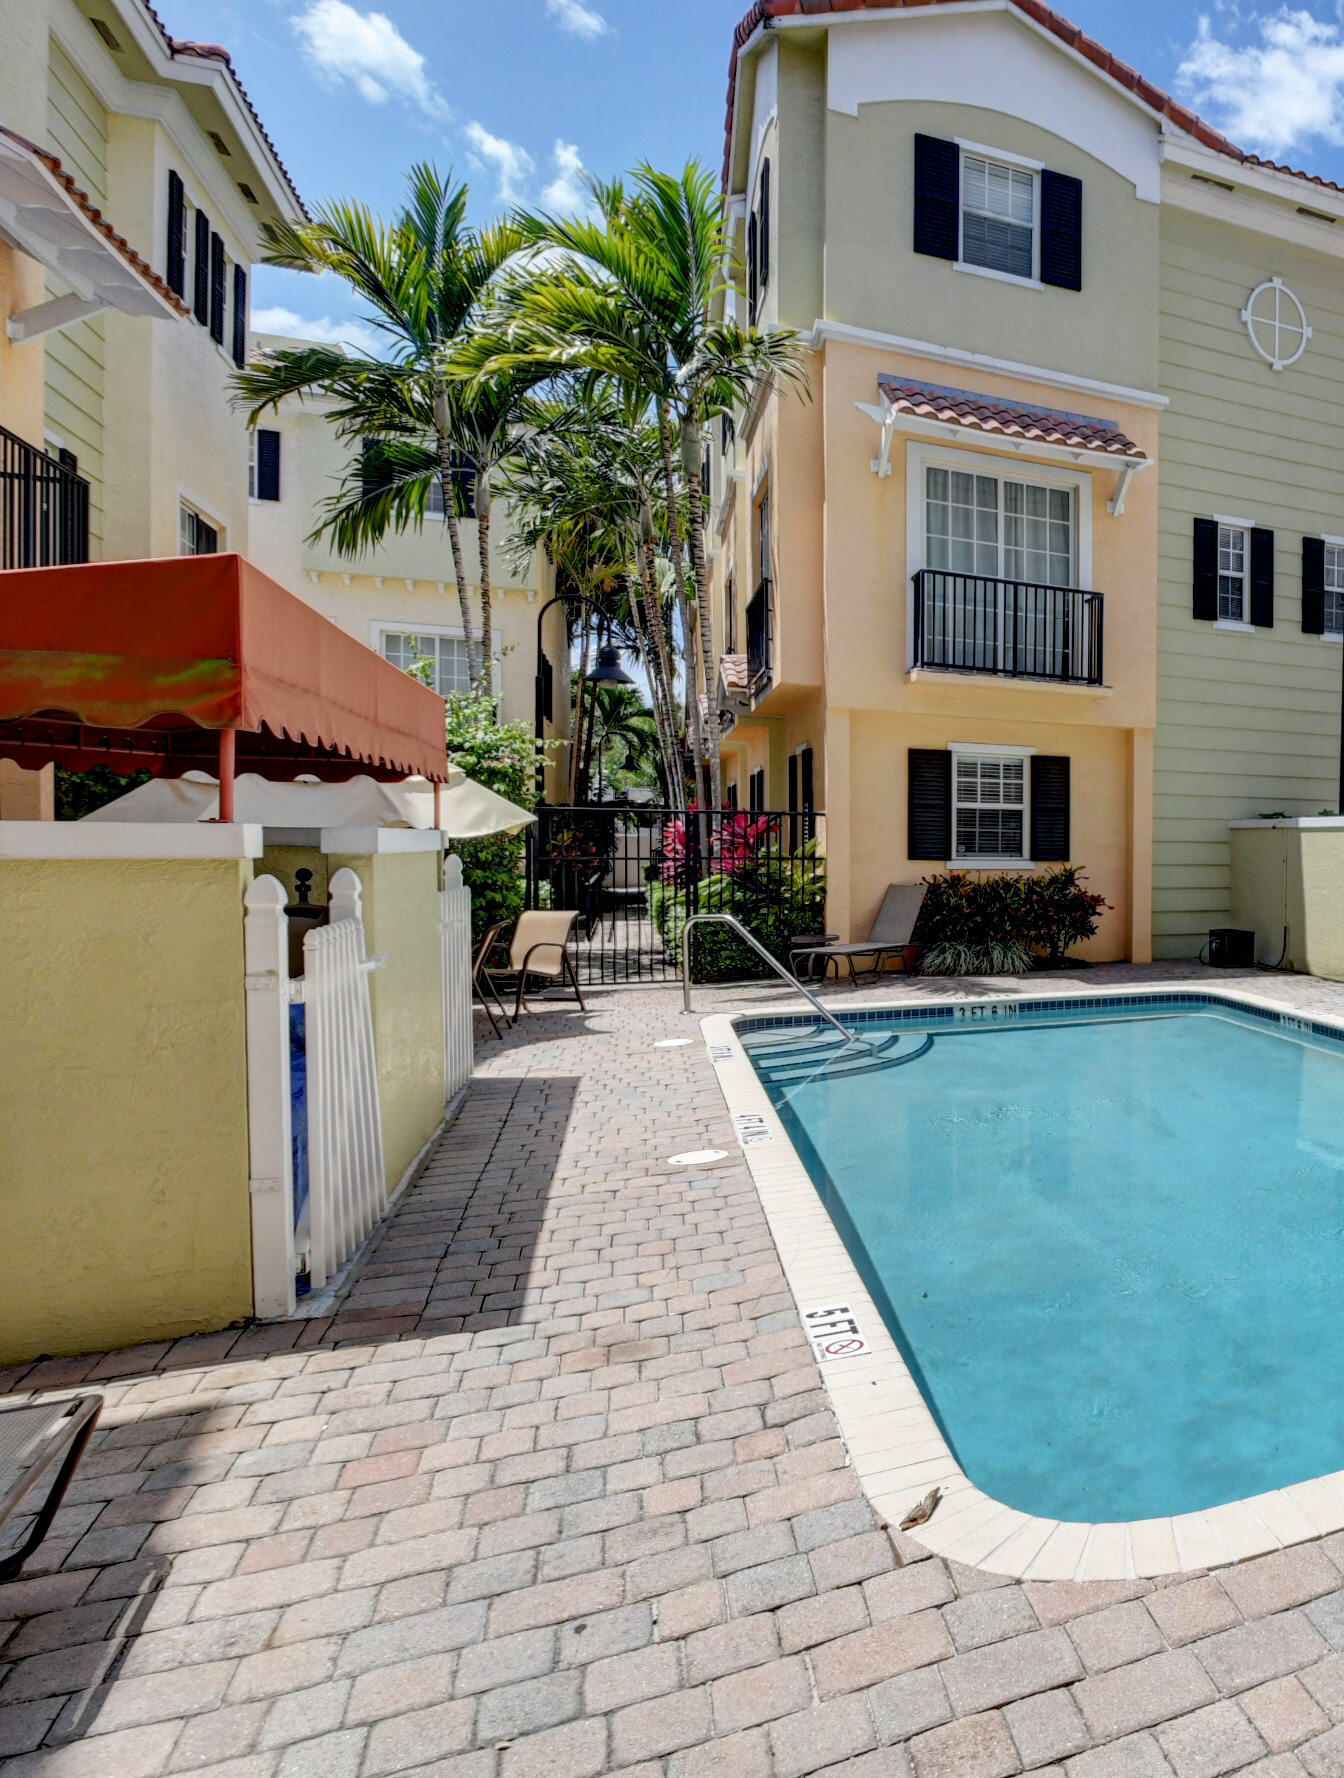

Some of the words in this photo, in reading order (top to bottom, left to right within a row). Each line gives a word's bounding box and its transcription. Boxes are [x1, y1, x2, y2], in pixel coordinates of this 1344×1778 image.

[1004, 1004, 1017, 1014] IN
[805, 1306, 850, 1318] 5
[810, 1319, 859, 1338] FT
